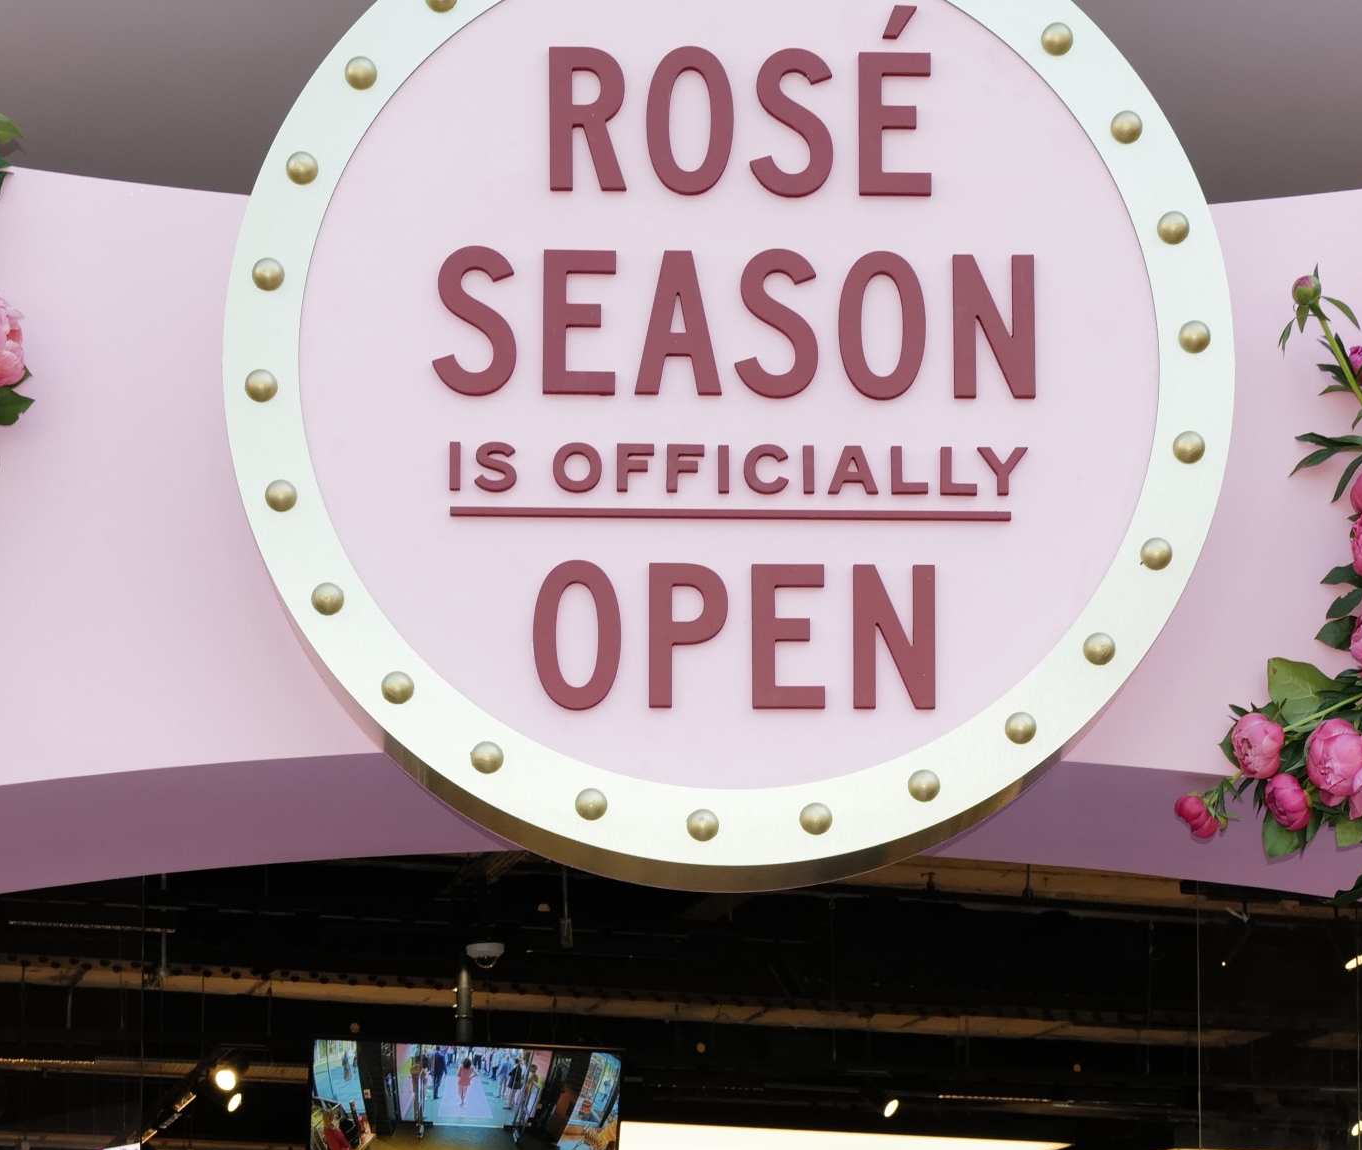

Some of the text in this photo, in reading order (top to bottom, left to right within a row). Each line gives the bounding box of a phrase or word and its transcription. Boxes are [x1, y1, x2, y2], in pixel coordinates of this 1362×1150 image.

[548, 5, 932, 197] ROSÉ
[432, 245, 1037, 401] SEASON
[448, 441, 1029, 497] IS OFFICIALLY
[532, 559, 937, 711] OPEN
